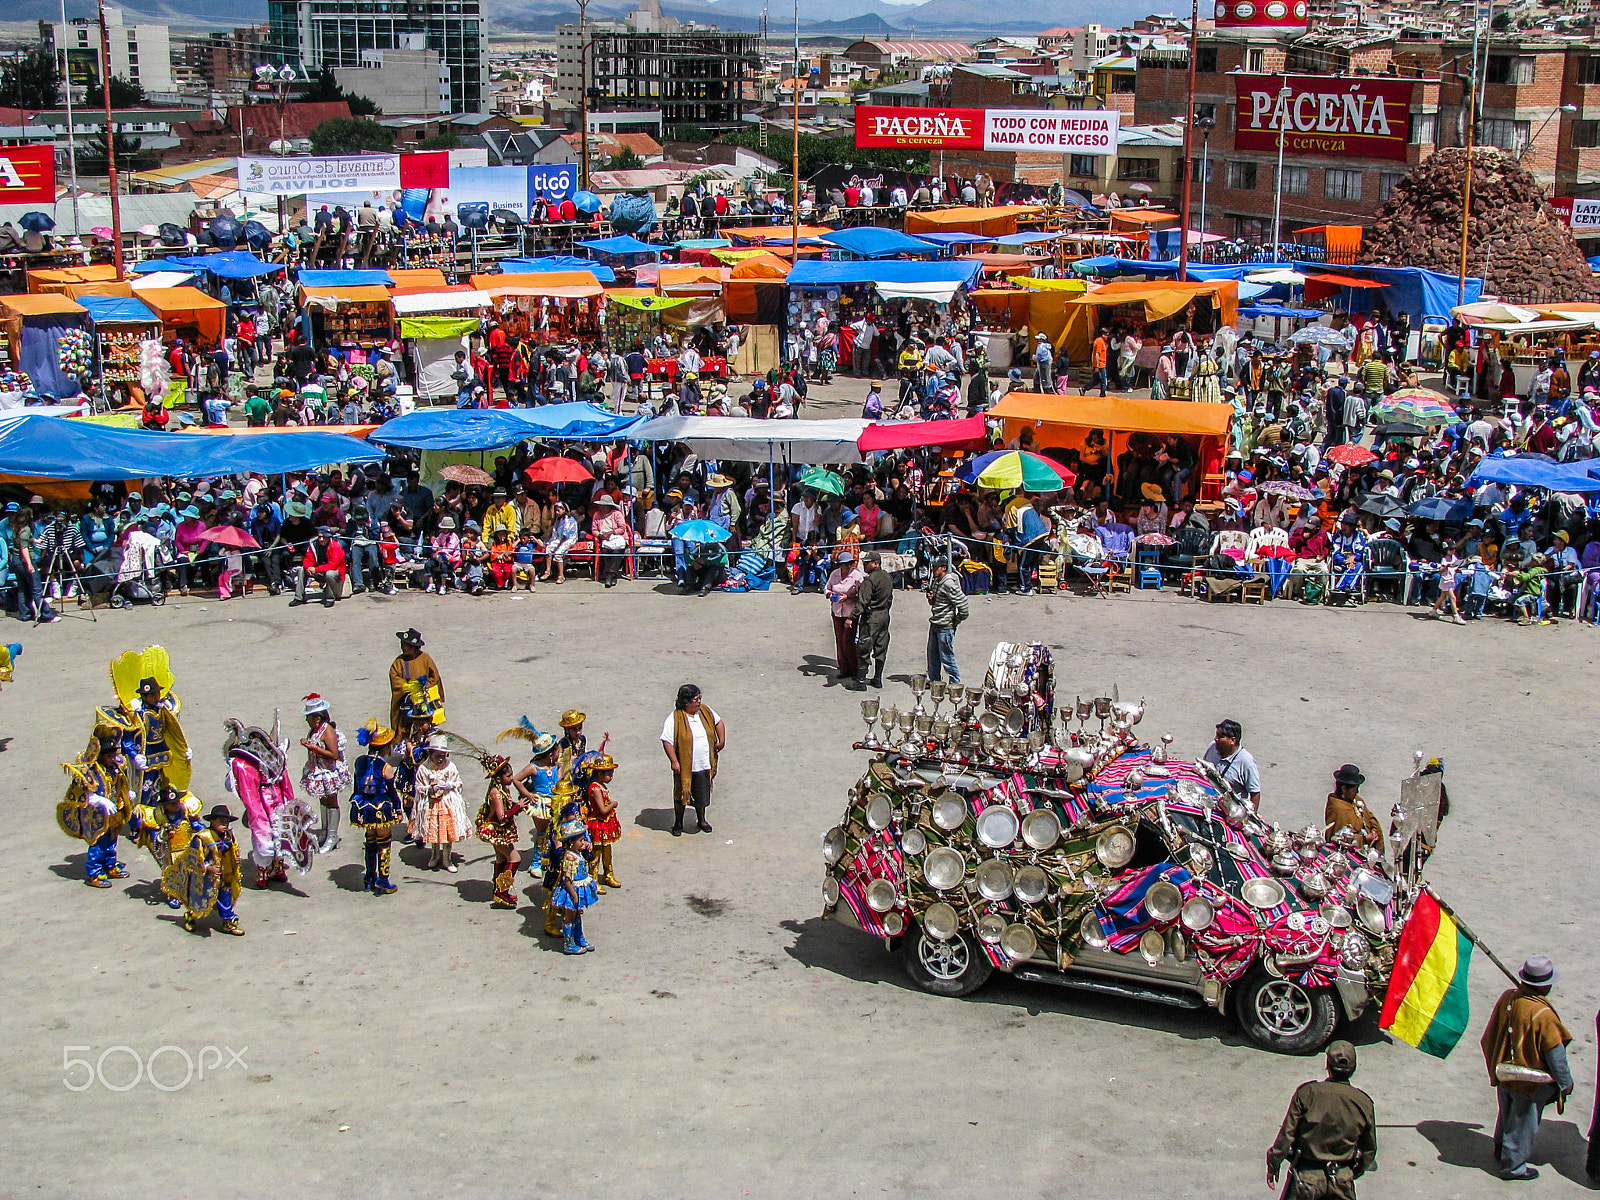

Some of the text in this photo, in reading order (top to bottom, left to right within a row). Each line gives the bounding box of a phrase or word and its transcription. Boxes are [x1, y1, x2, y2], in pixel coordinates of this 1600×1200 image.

[1251, 84, 1391, 135] PACEÑA
[875, 113, 965, 136] PACEÑA
[992, 118, 1109, 131] TODO CON MEDIDA
[991, 132, 1109, 146] NADA CON EXCESO
[1275, 136, 1346, 151] es cerveza
[493, 201, 523, 210] Business
